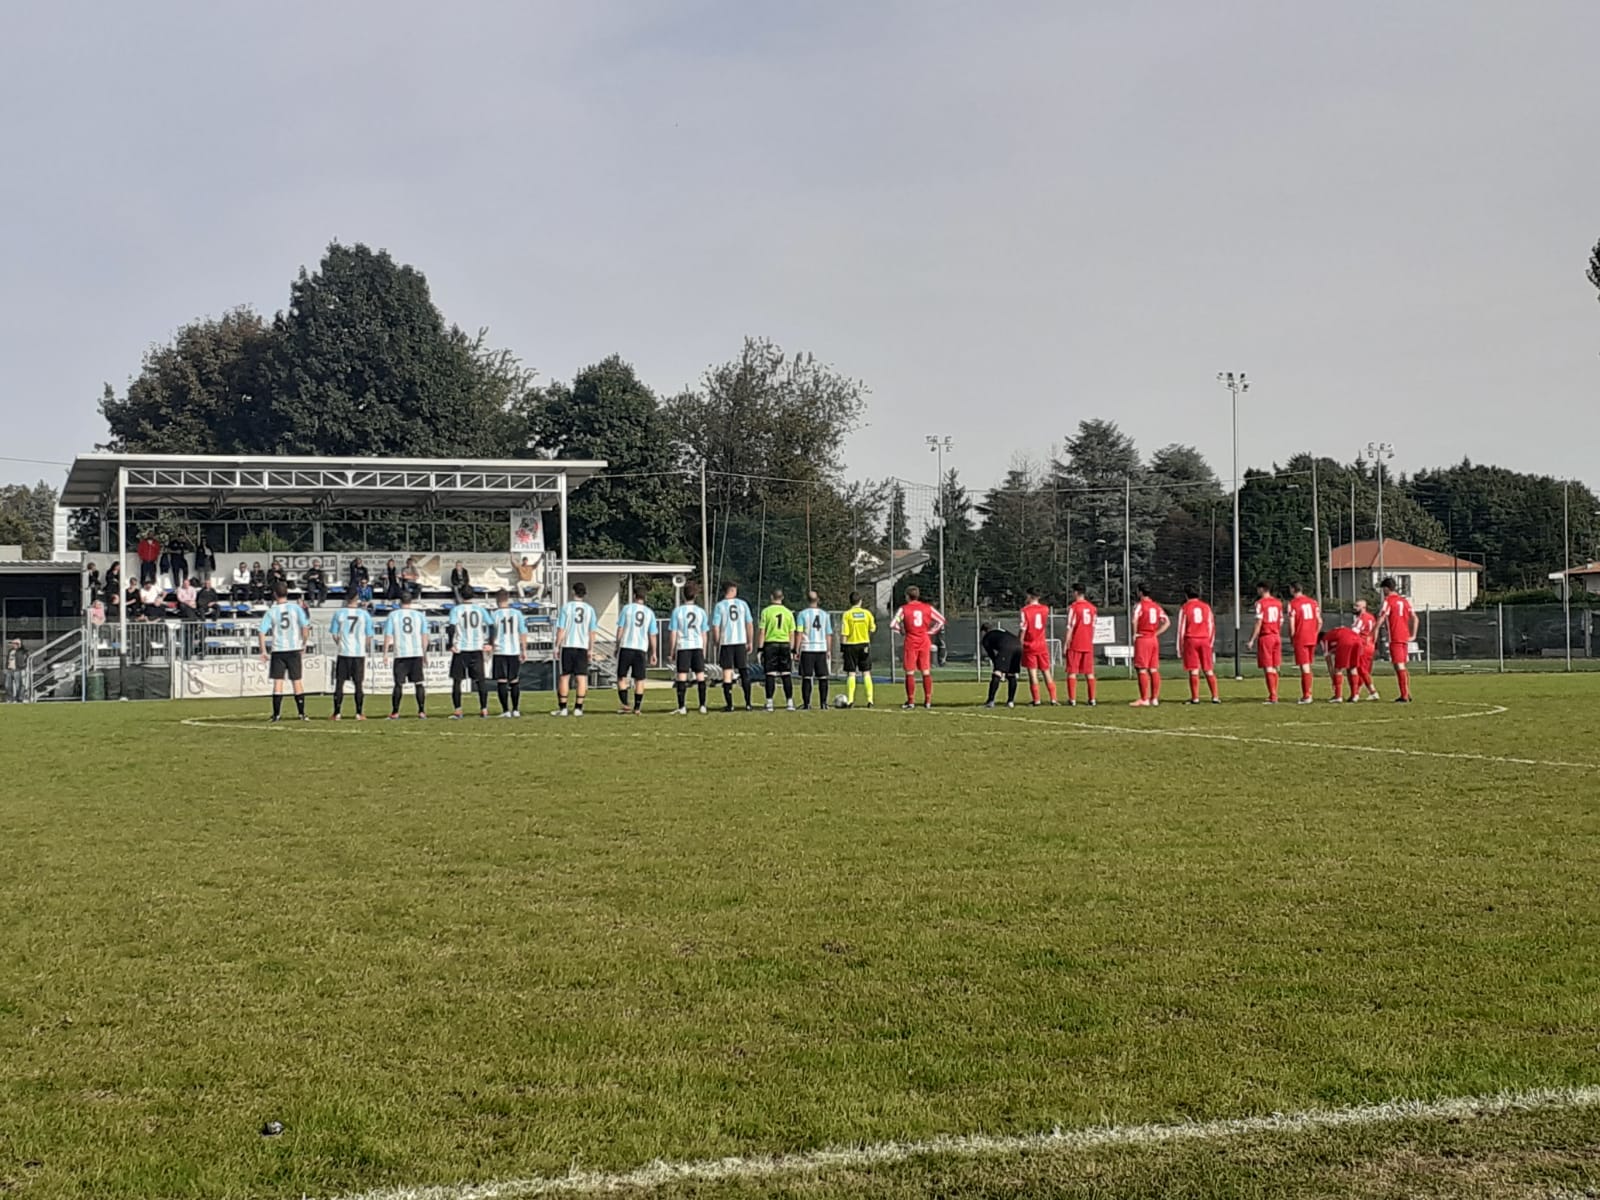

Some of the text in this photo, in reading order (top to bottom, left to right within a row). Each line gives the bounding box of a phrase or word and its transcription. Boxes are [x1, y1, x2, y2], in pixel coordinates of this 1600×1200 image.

[574, 607, 584, 624] 3
[636, 611, 645, 628] 9
[729, 604, 738, 621] 6
[913, 609, 923, 626] 3
[1268, 606, 1279, 622] 10
[1301, 603, 1313, 619] 11
[281, 611, 290, 630] 5
[348, 616, 358, 633] 7
[402, 616, 413, 634] 8
[462, 611, 479, 630] 10
[501, 616, 513, 635] 11
[686, 612, 696, 629] 2
[774, 613, 782, 630] 1
[812, 615, 822, 631] 4
[1035, 613, 1043, 630] 4
